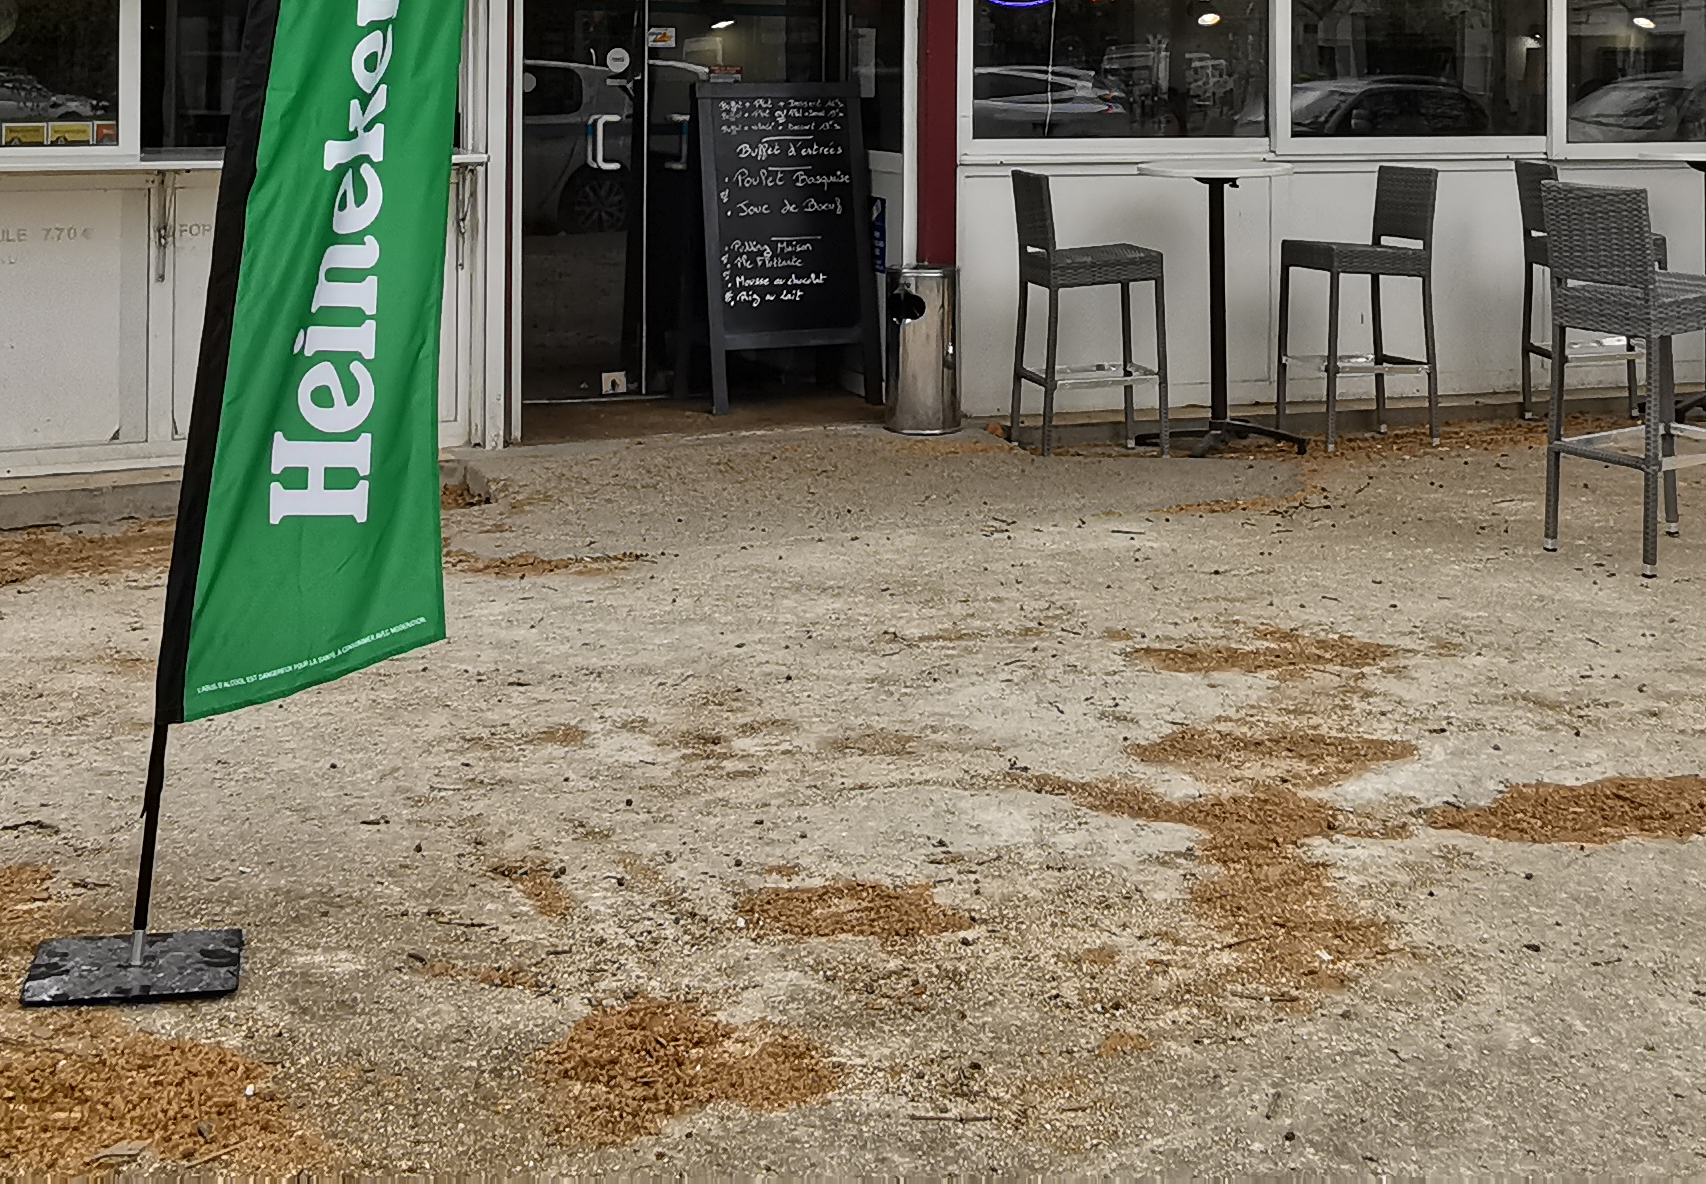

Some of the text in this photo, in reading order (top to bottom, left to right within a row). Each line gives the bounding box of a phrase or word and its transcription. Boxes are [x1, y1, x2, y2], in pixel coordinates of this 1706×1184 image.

[736, 142, 781, 161] Buffet
[733, 168, 786, 188] Poulet
[736, 199, 771, 217] Joue
[780, 198, 799, 215] de
